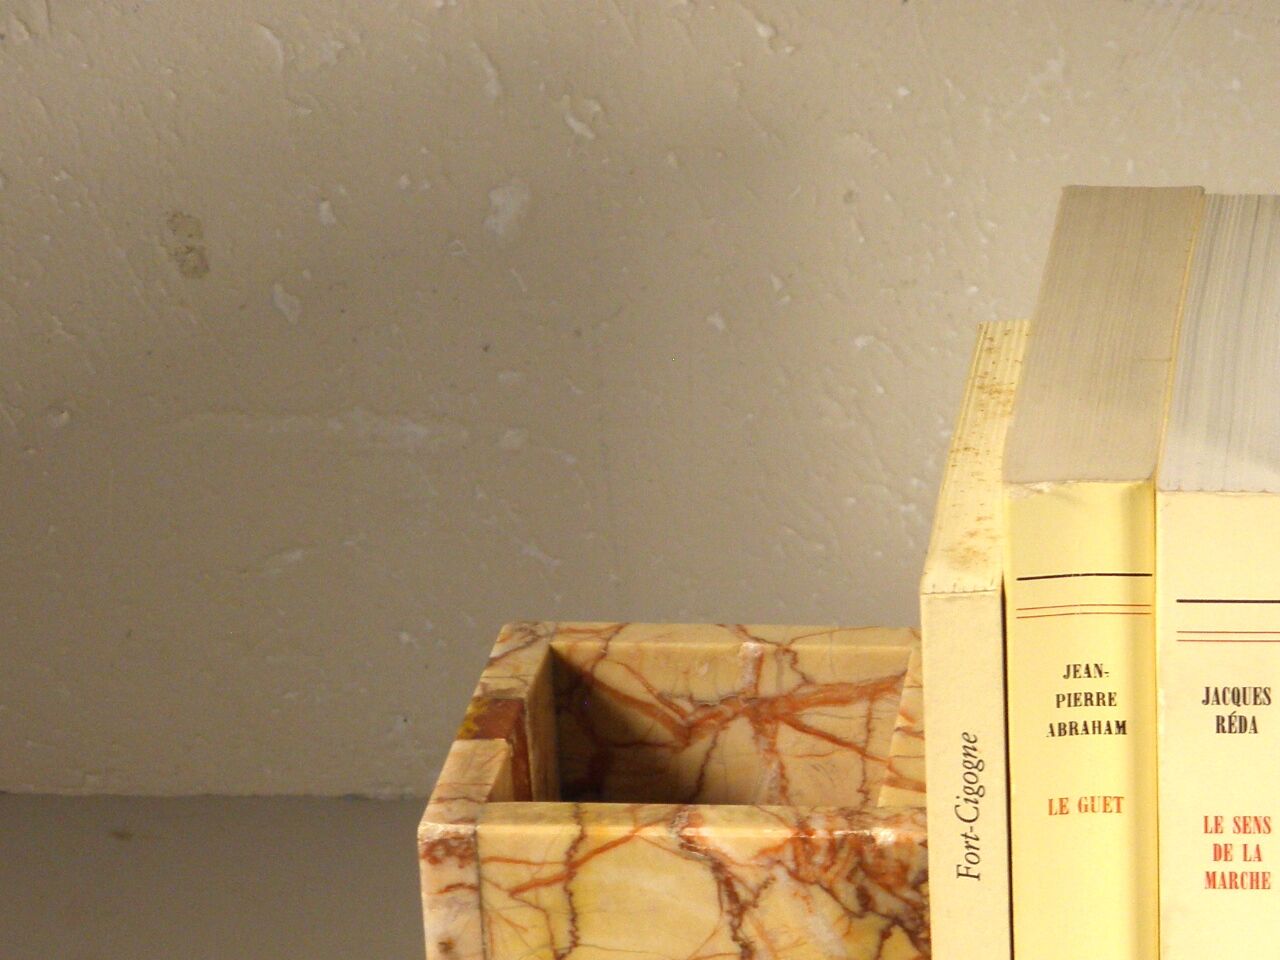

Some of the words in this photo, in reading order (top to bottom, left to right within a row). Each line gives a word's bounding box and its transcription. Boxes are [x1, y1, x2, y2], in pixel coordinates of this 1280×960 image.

[1063, 664, 1109, 679] JEAN-
[1056, 692, 1117, 708] PIERRE
[1202, 687, 1271, 707] JACQUES
[1046, 721, 1128, 738] ABRAHAM
[1216, 711, 1258, 734] RÉDA
[955, 732, 985, 880] Fort-Cigogne
[1049, 798, 1069, 816] LE
[1078, 796, 1124, 813] GUET
[1204, 816, 1223, 834] LE
[1233, 816, 1271, 834] SENS
[1213, 843, 1232, 861] DE
[1243, 844, 1262, 862] LA
[1206, 871, 1270, 890] MARCHE
